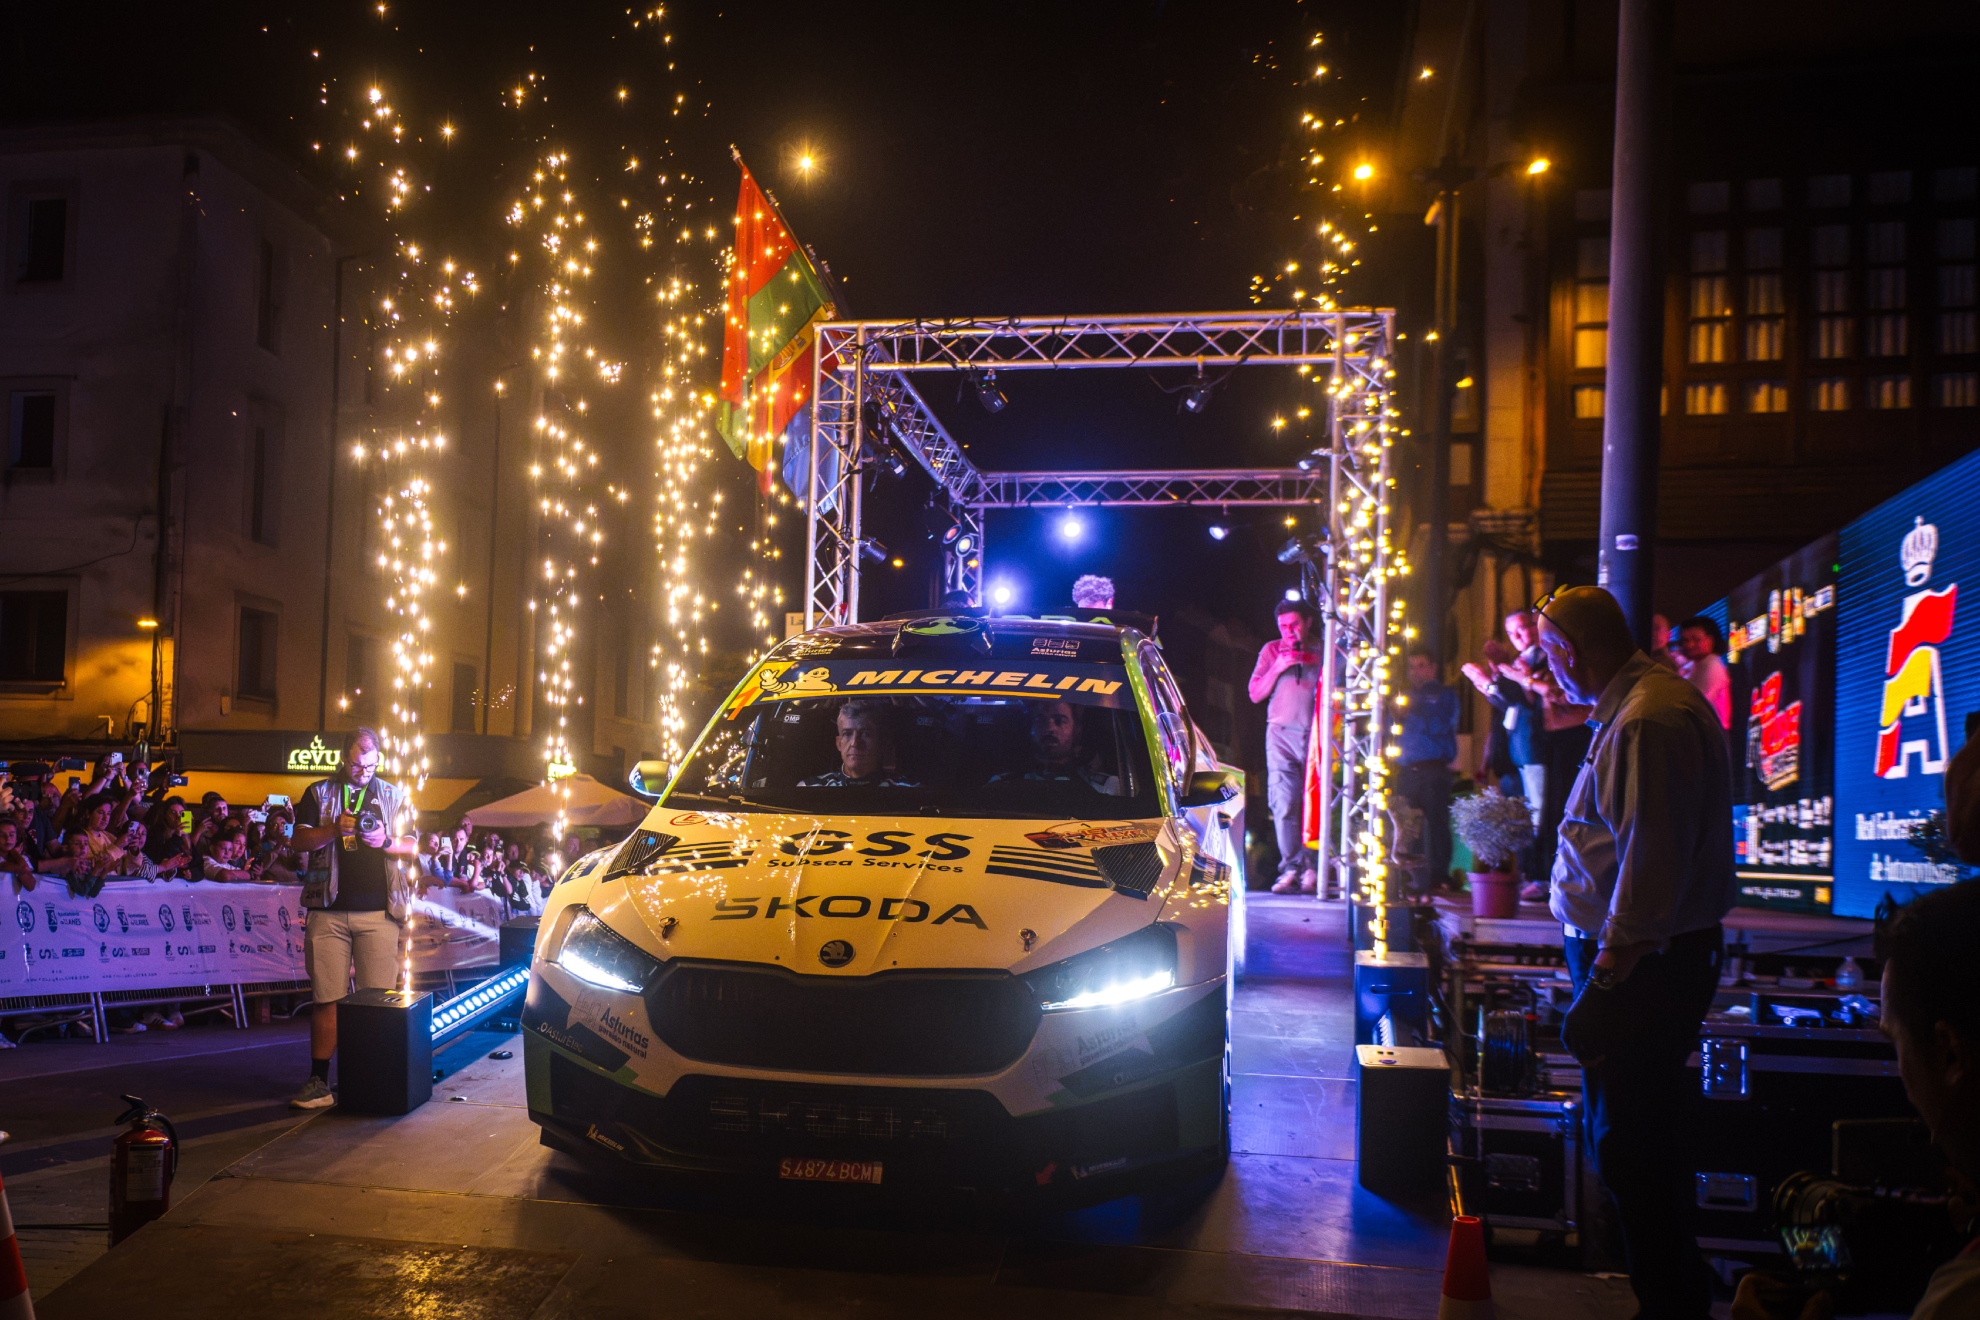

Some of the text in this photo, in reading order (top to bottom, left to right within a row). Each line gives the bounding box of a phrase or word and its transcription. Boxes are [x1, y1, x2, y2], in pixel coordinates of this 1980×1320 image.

[846, 669, 1123, 695] MICHELIN
[779, 829, 974, 861] GSS
[767, 858, 964, 873] Subsea Services
[600, 1007, 649, 1049] Asturias
[622, 1040, 648, 1060] natural
